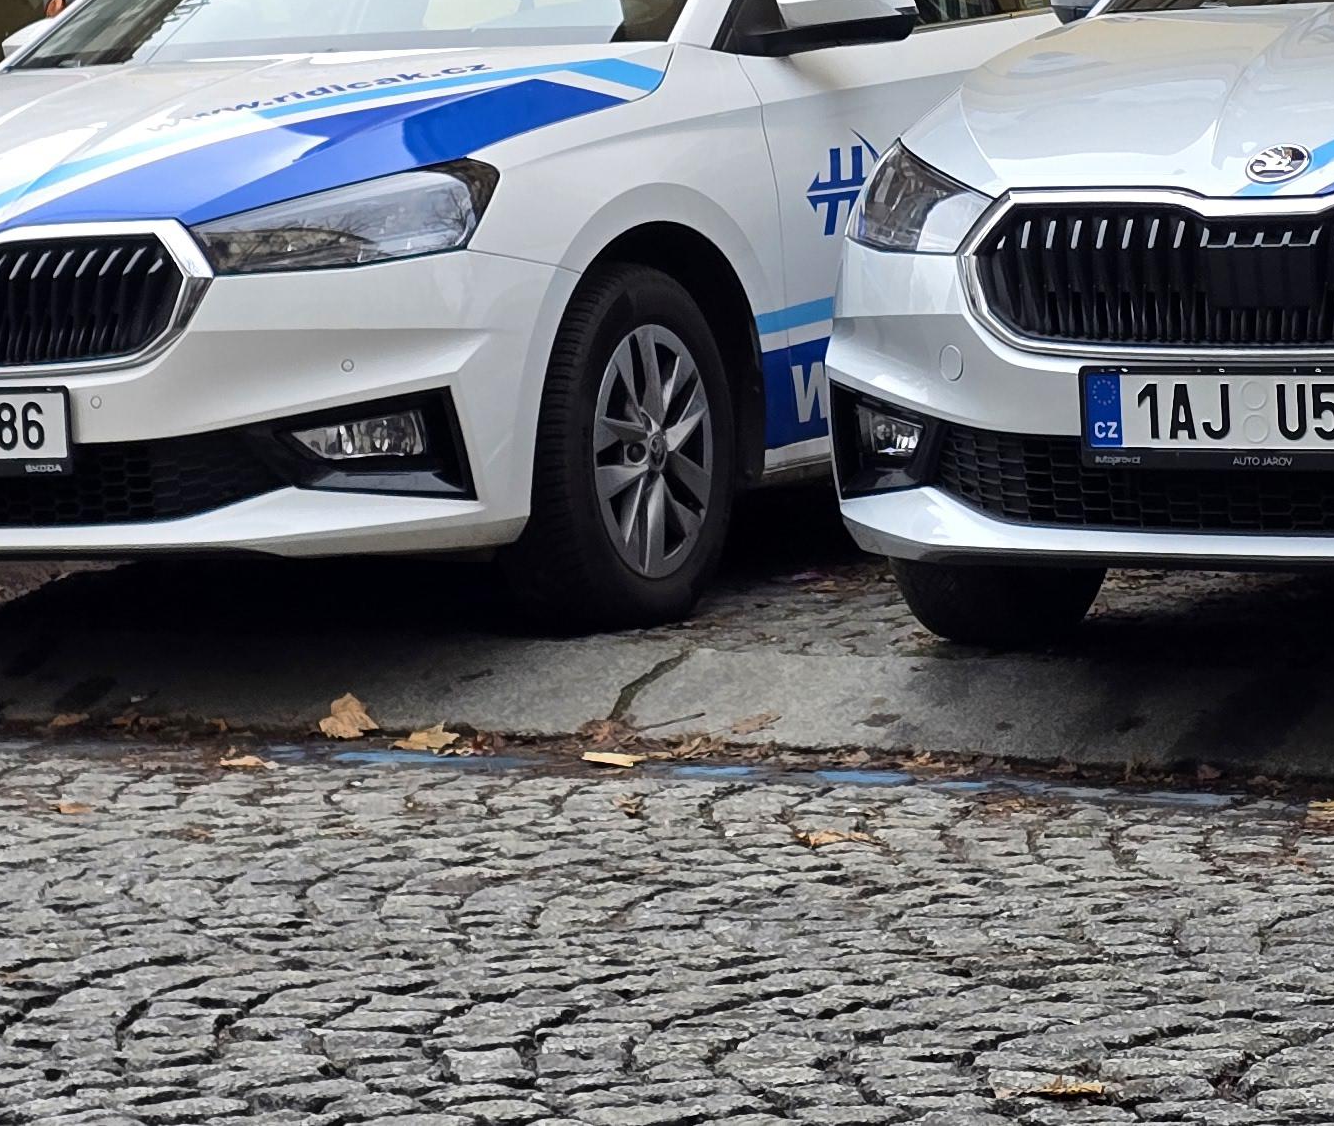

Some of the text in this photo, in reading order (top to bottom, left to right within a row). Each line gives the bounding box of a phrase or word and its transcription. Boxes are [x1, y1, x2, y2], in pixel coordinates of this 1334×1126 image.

[1094, 421, 1119, 439] CZ
[1136, 383, 1231, 441] 1AJ
[1232, 456, 1293, 467] AUTO JAROV
